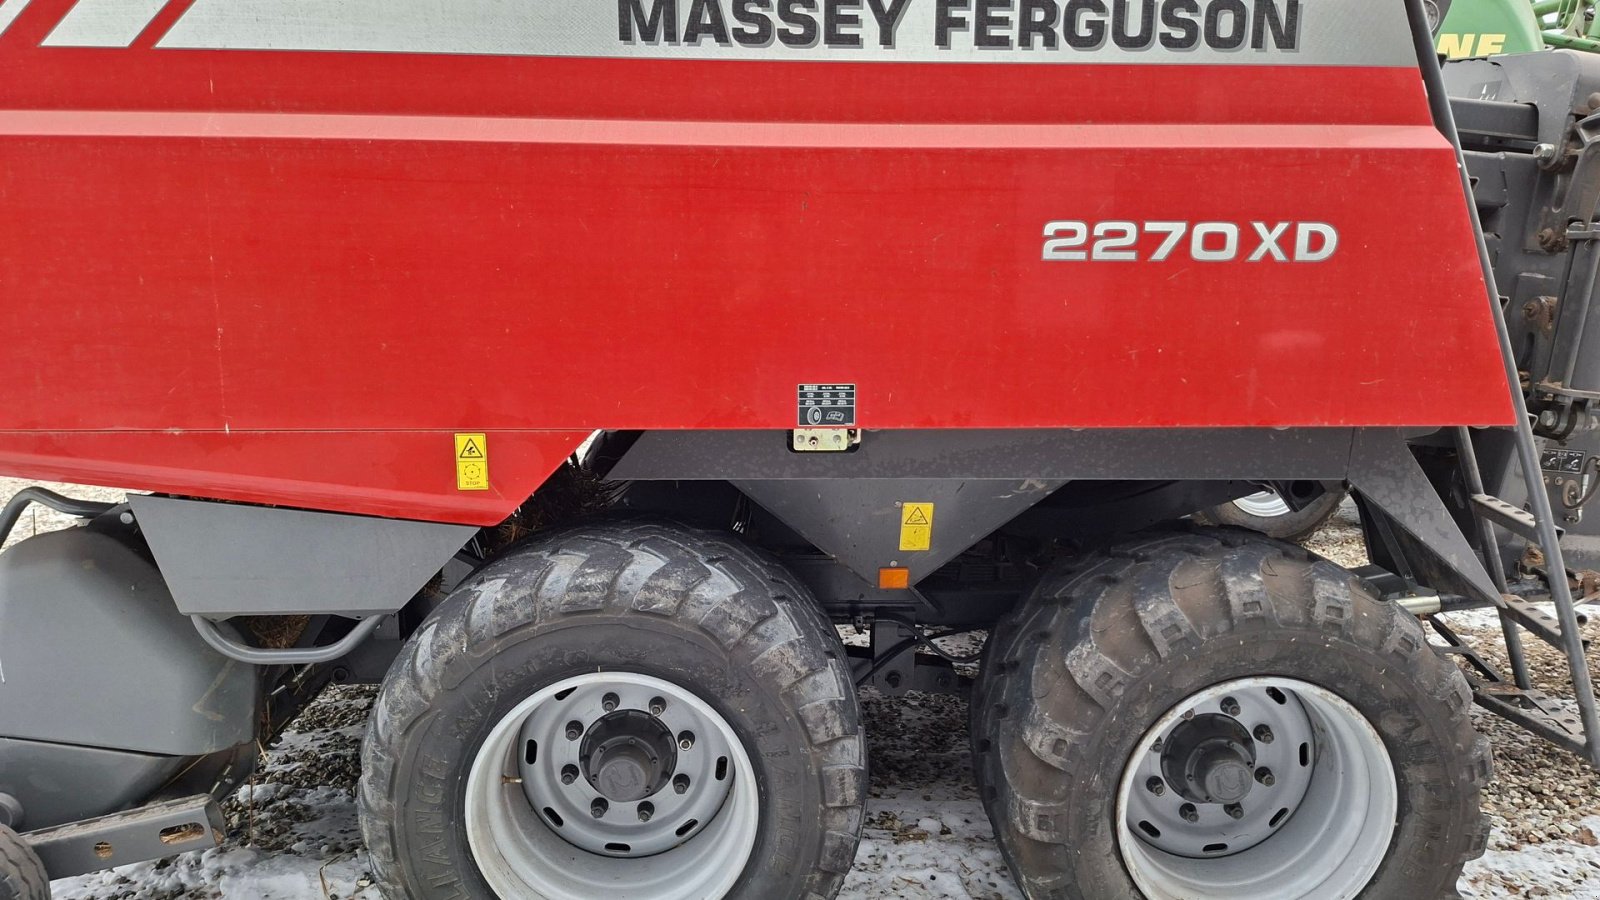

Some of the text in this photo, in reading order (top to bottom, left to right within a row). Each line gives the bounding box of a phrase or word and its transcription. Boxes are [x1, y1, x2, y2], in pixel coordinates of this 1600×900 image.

[618, 0, 1301, 52] MASSEY FERGUSON
[1041, 219, 1339, 262] 2270 XD
